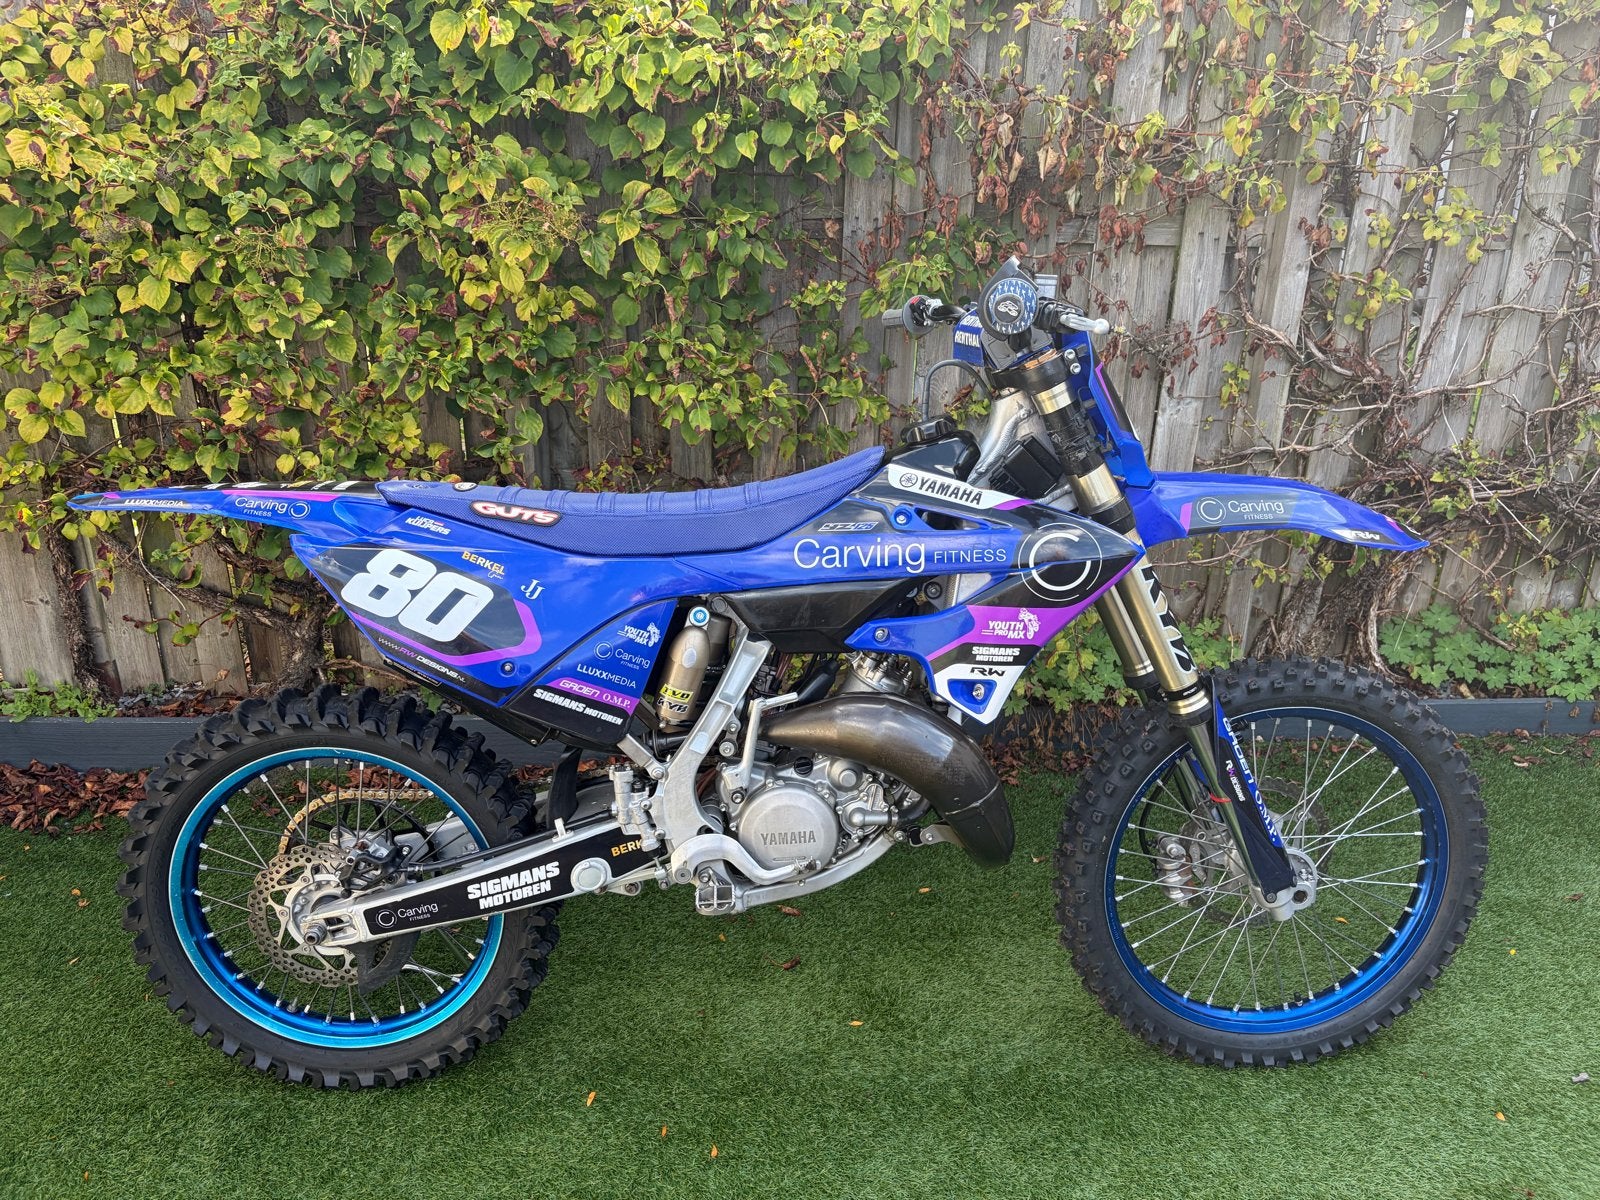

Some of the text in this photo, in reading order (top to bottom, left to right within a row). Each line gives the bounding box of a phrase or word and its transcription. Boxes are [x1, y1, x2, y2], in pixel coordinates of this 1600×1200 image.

[917, 476, 983, 506] YAMAHA
[235, 497, 288, 514] Carving
[243, 508, 272, 517] FITNESS
[472, 501, 560, 524] GUTS
[1228, 500, 1284, 514] Carving
[461, 550, 505, 576] BERKEL
[794, 538, 1006, 573] Carving FITNESS
[340, 549, 495, 642] 80
[520, 579, 546, 600] JJ
[624, 625, 650, 639] YOUTH
[988, 620, 1024, 631] YOUTH
[635, 636, 649, 646] MX
[1007, 630, 1026, 639] MX
[615, 649, 651, 669] Carving
[971, 646, 1020, 656] SIGMANS
[620, 661, 640, 670] FITNESS
[970, 667, 1006, 676] RW
[577, 664, 636, 689] LLUXXMEDIA
[533, 688, 624, 726] SIGMANS MOTOREN
[602, 693, 631, 708] O.M.P.
[760, 829, 817, 846] YAMAHA
[467, 861, 560, 899] SIGMANS
[479, 880, 551, 910] MOTOREN
[397, 903, 439, 918] Carving
